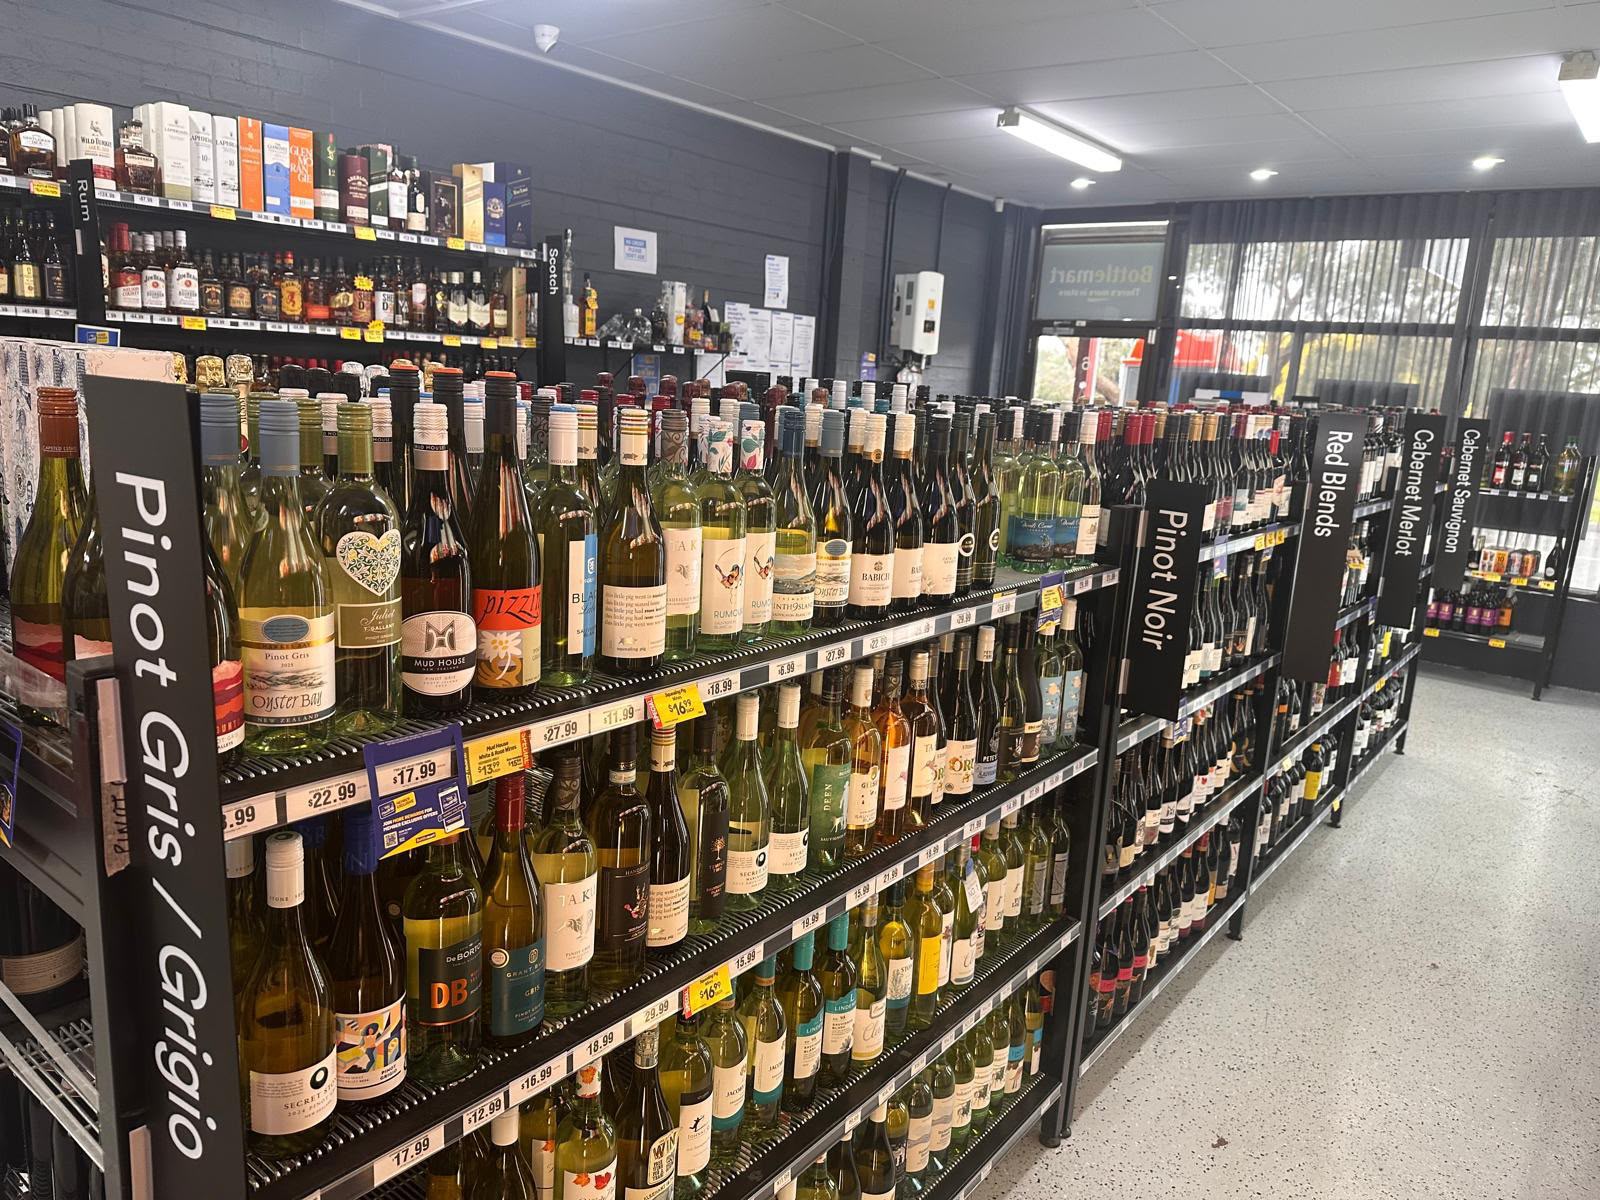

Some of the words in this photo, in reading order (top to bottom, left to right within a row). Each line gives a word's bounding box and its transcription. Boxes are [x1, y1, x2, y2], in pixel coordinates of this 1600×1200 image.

[76, 179, 91, 222] Rum
[549, 248, 559, 295] Scotch
[1324, 430, 1353, 466] Red
[1456, 428, 1481, 488] Cabernet
[1404, 428, 1435, 502] Cabernet
[1314, 471, 1347, 538] Blends
[1395, 504, 1423, 556] Merlot
[1444, 488, 1471, 554] Sauvignon
[1150, 509, 1189, 582] Pinot
[115, 471, 177, 688] Pinot
[861, 573, 890, 582] BABICH
[1142, 588, 1179, 651] Noir
[265, 652, 290, 660] Pinot
[291, 652, 310, 660] Gris
[414, 659, 435, 668] MUD
[438, 657, 466, 667] HOUSE
[777, 663, 795, 676] $6.99
[252, 693, 300, 712] Oyster
[301, 690, 323, 707] Bay
[707, 679, 733, 696] $18.99
[603, 706, 634, 725] $11.99
[543, 721, 578, 743] $27.99
[392, 761, 437, 785] $17.99
[139, 710, 196, 868] Gris
[307, 782, 357, 809] $22.99
[823, 783, 833, 811] DEEN
[151, 876, 203, 940] /
[456, 942, 482, 961] BORTO
[735, 950, 756, 969] 15.99
[430, 978, 468, 1009] DB
[154, 944, 217, 1161] Grigio
[521, 1066, 552, 1091] $16.99
[283, 1092, 319, 1111] SECRET
[467, 1098, 502, 1125] $12.99
